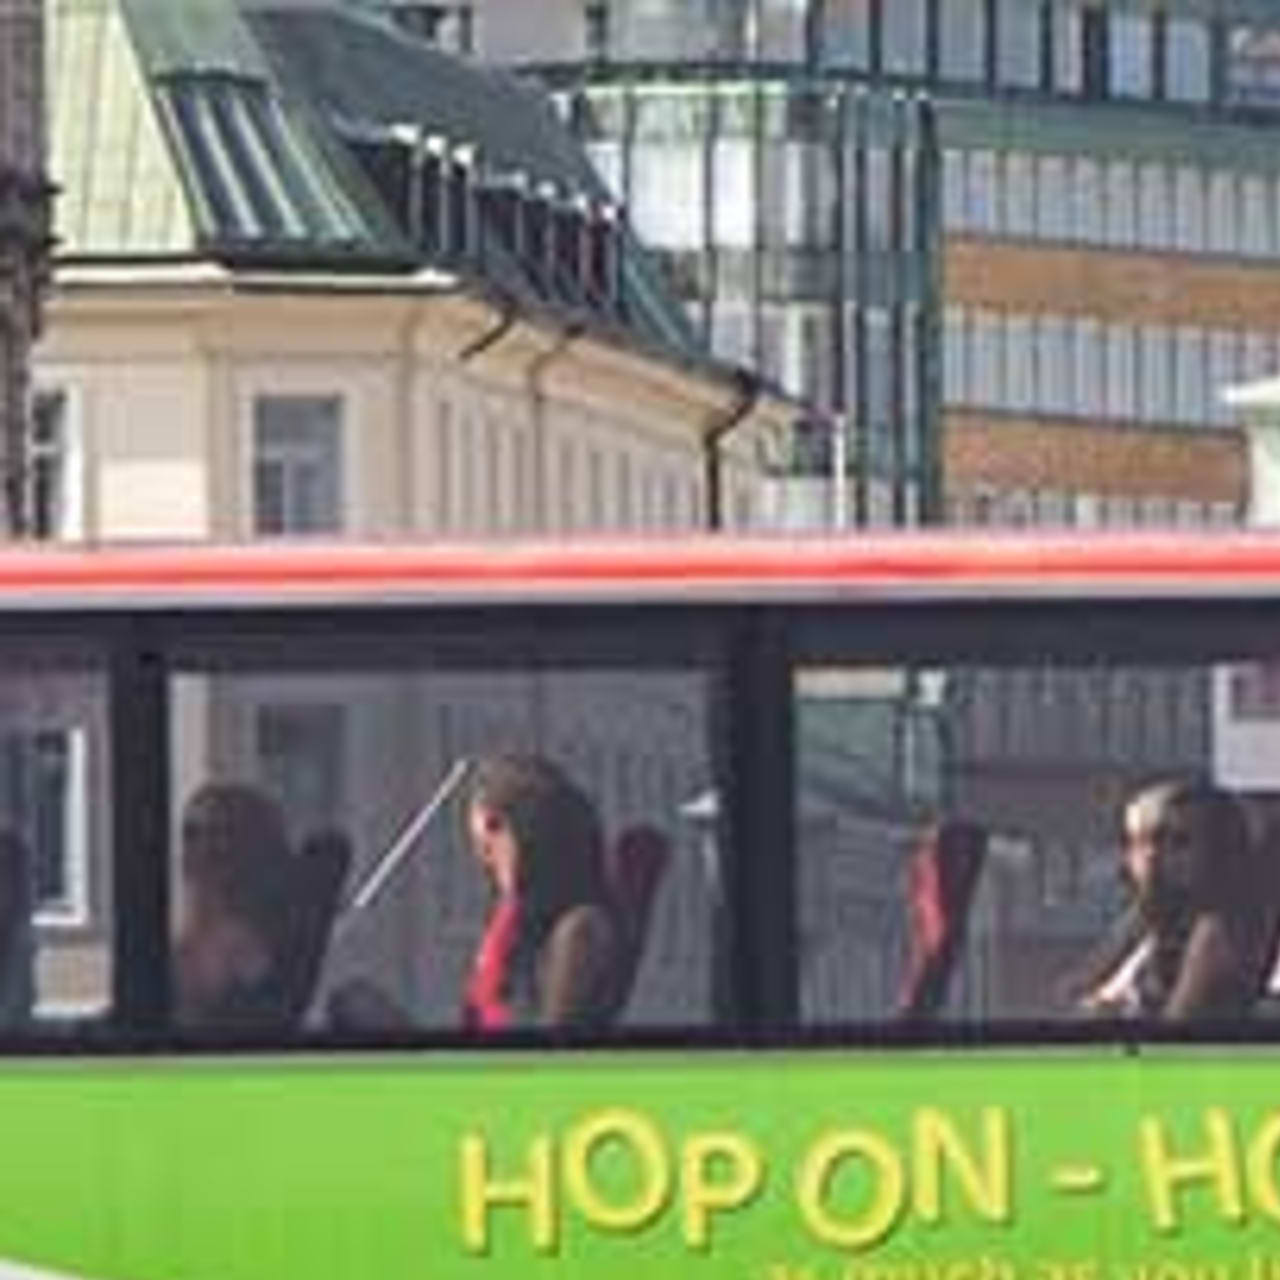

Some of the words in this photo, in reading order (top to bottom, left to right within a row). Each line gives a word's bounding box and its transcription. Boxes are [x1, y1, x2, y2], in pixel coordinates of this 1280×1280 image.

[458, 1105, 768, 1256] HOP
[796, 1103, 1014, 1250] ON
[1052, 1162, 1101, 1194] -
